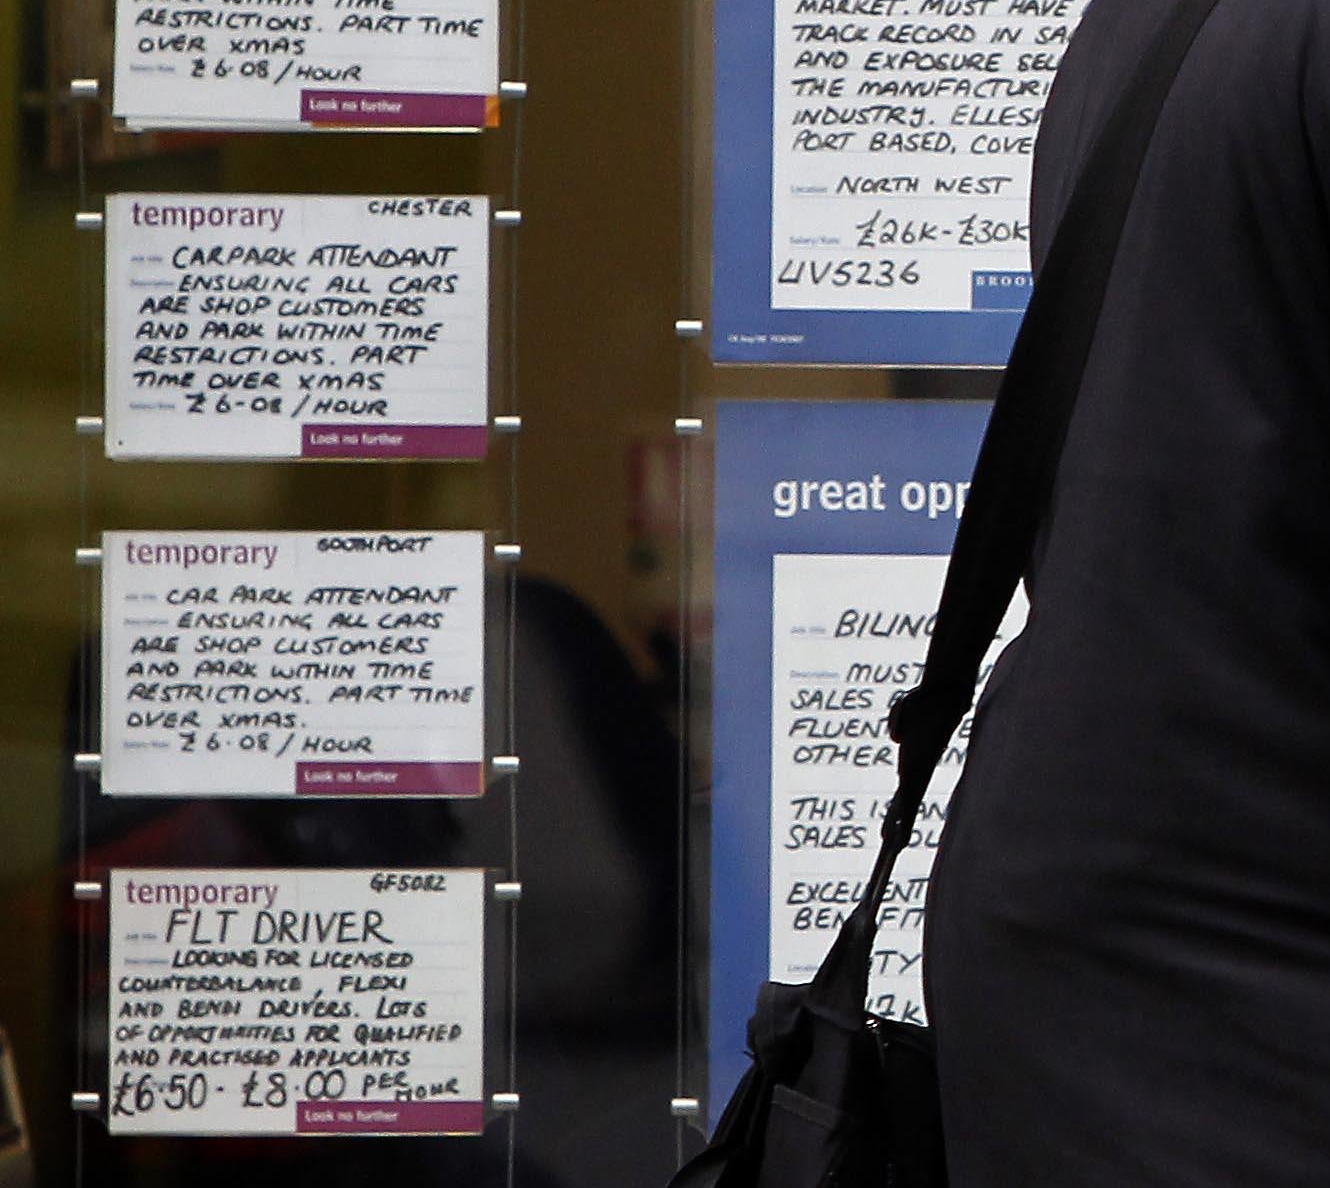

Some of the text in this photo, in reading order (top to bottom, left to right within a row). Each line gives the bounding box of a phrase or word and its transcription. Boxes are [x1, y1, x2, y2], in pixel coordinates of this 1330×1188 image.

[133, 203, 283, 231] temporary
[774, 475, 885, 517] great
[126, 541, 277, 569] temporary
[791, 797, 855, 821] THIS
[126, 880, 277, 911] temporary
[166, 905, 393, 944] FLT DRIVER
